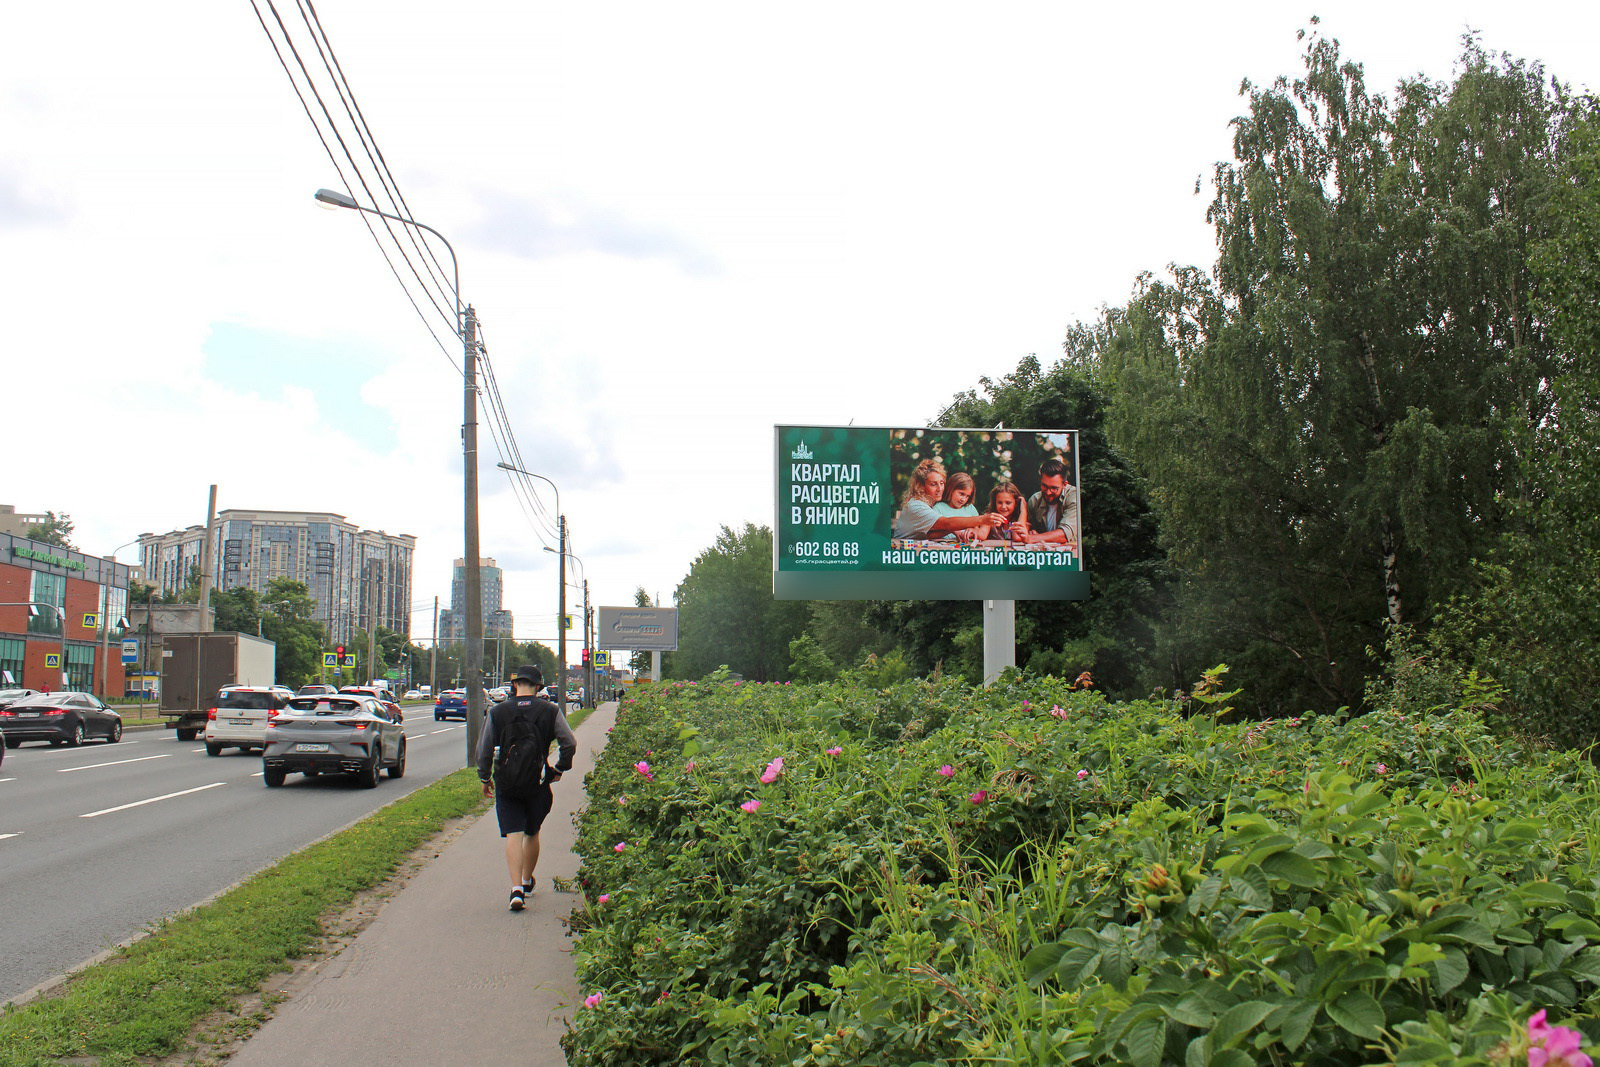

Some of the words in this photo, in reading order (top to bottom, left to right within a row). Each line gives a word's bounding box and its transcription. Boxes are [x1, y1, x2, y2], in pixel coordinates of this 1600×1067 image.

[791, 463, 861, 482] КВАРТАЛ
[791, 482, 880, 506] РАСЦВЕТАЙ
[791, 506, 802, 525] В
[805, 506, 860, 526] ЯНИНО
[795, 541, 820, 557] 602
[823, 541, 840, 557] 68
[842, 541, 860, 557] 68
[882, 550, 916, 565] наш
[920, 547, 1004, 566] семейный
[1008, 551, 1073, 570] квартал
